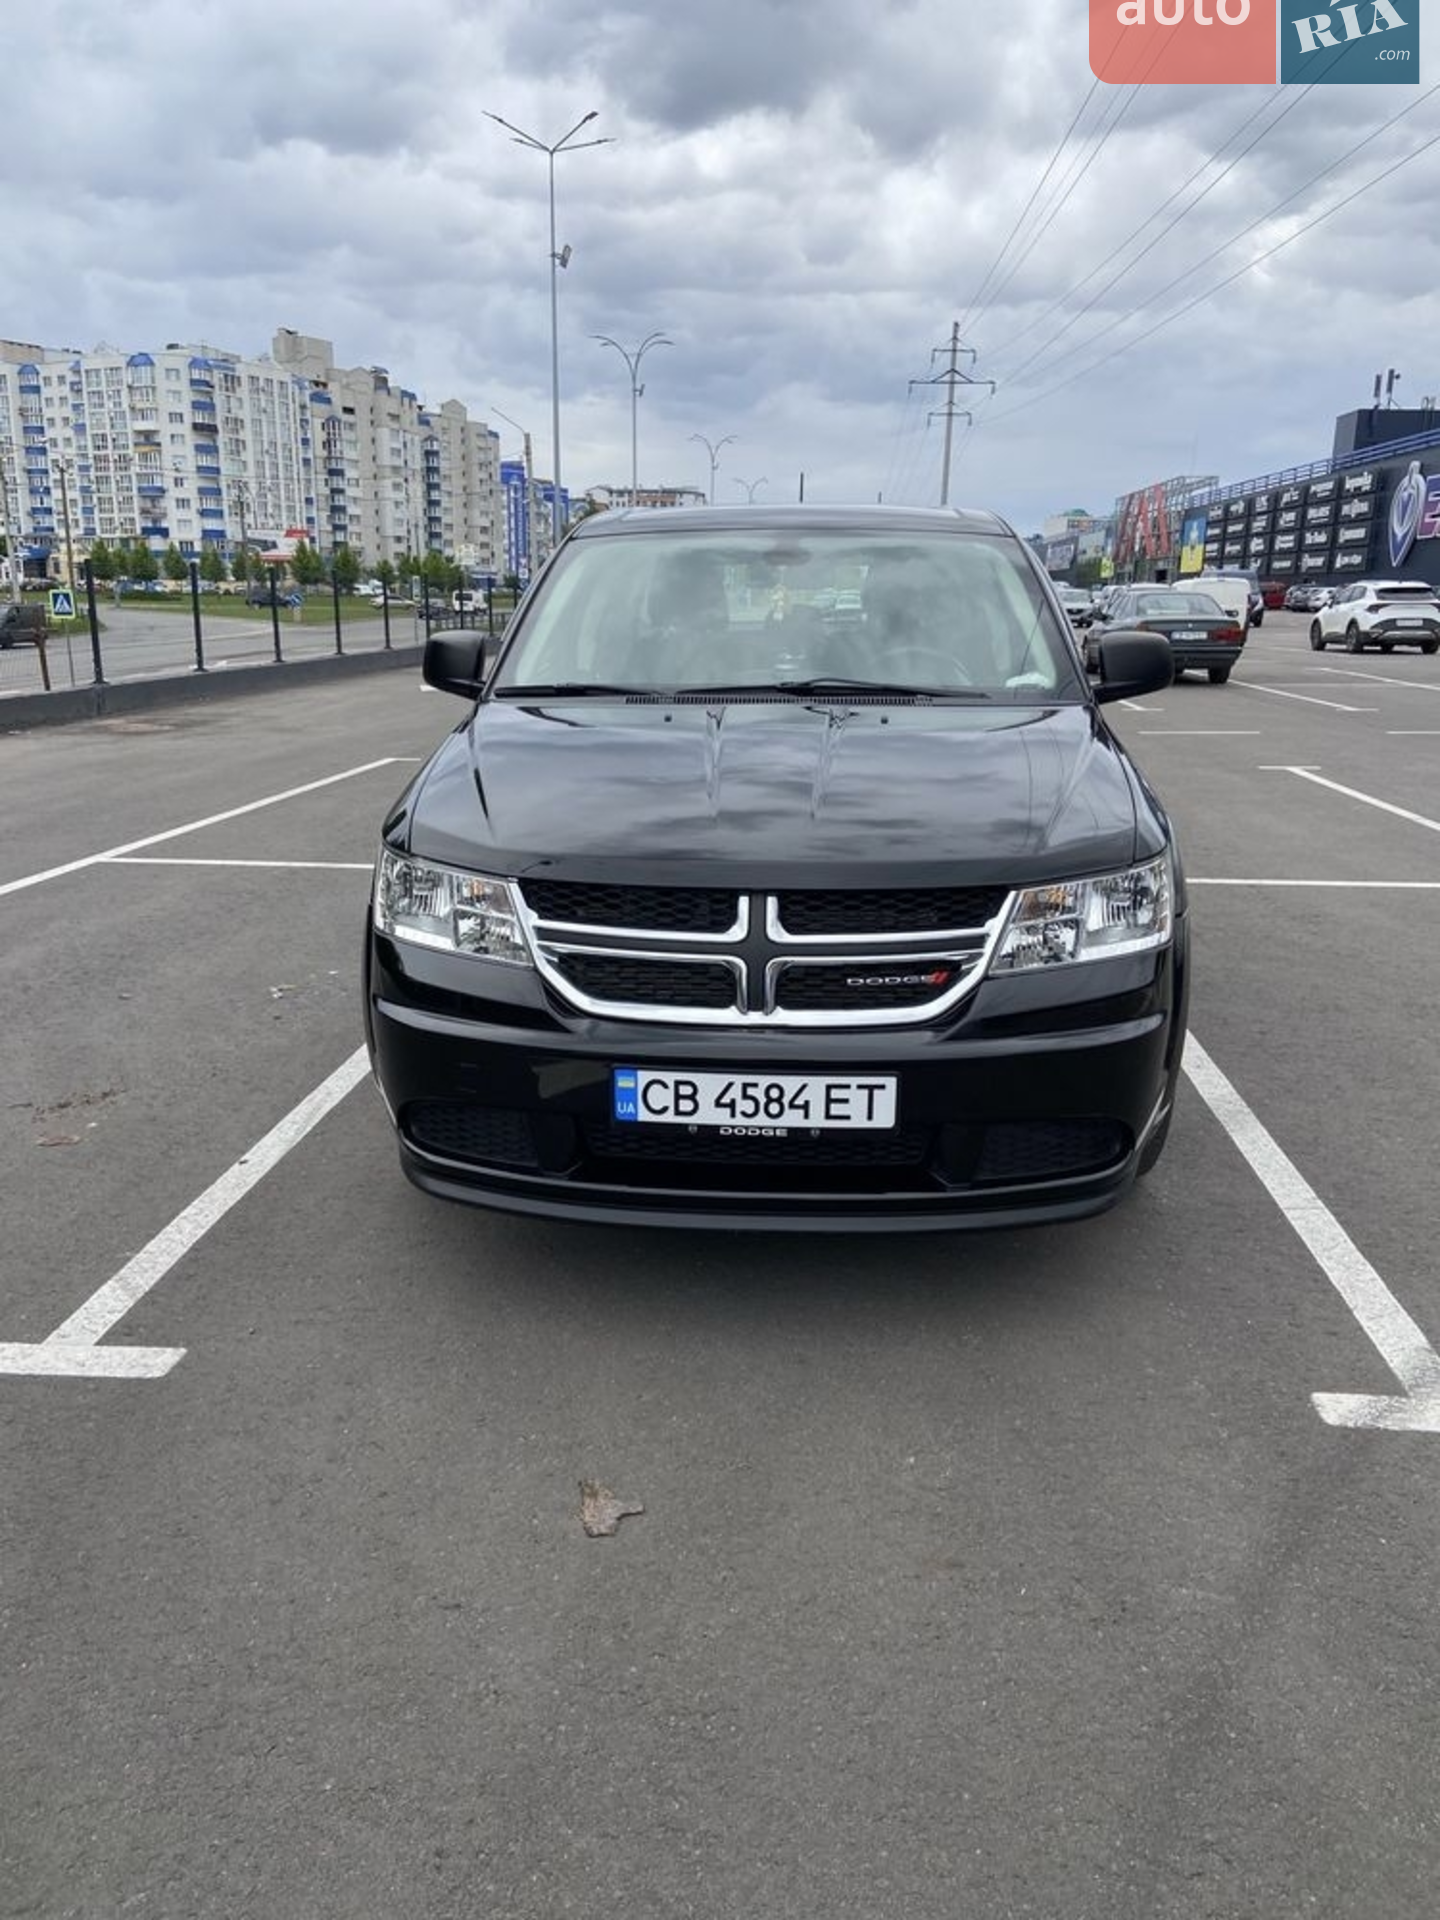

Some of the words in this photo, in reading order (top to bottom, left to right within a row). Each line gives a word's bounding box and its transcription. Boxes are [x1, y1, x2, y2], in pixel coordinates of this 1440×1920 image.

[846, 974, 935, 986] DODGE
[641, 1078, 699, 1117] CB
[714, 1081, 810, 1120] 4584
[824, 1084, 886, 1121] ET
[617, 1101, 636, 1115] UA
[719, 1126, 788, 1137] DODGE
